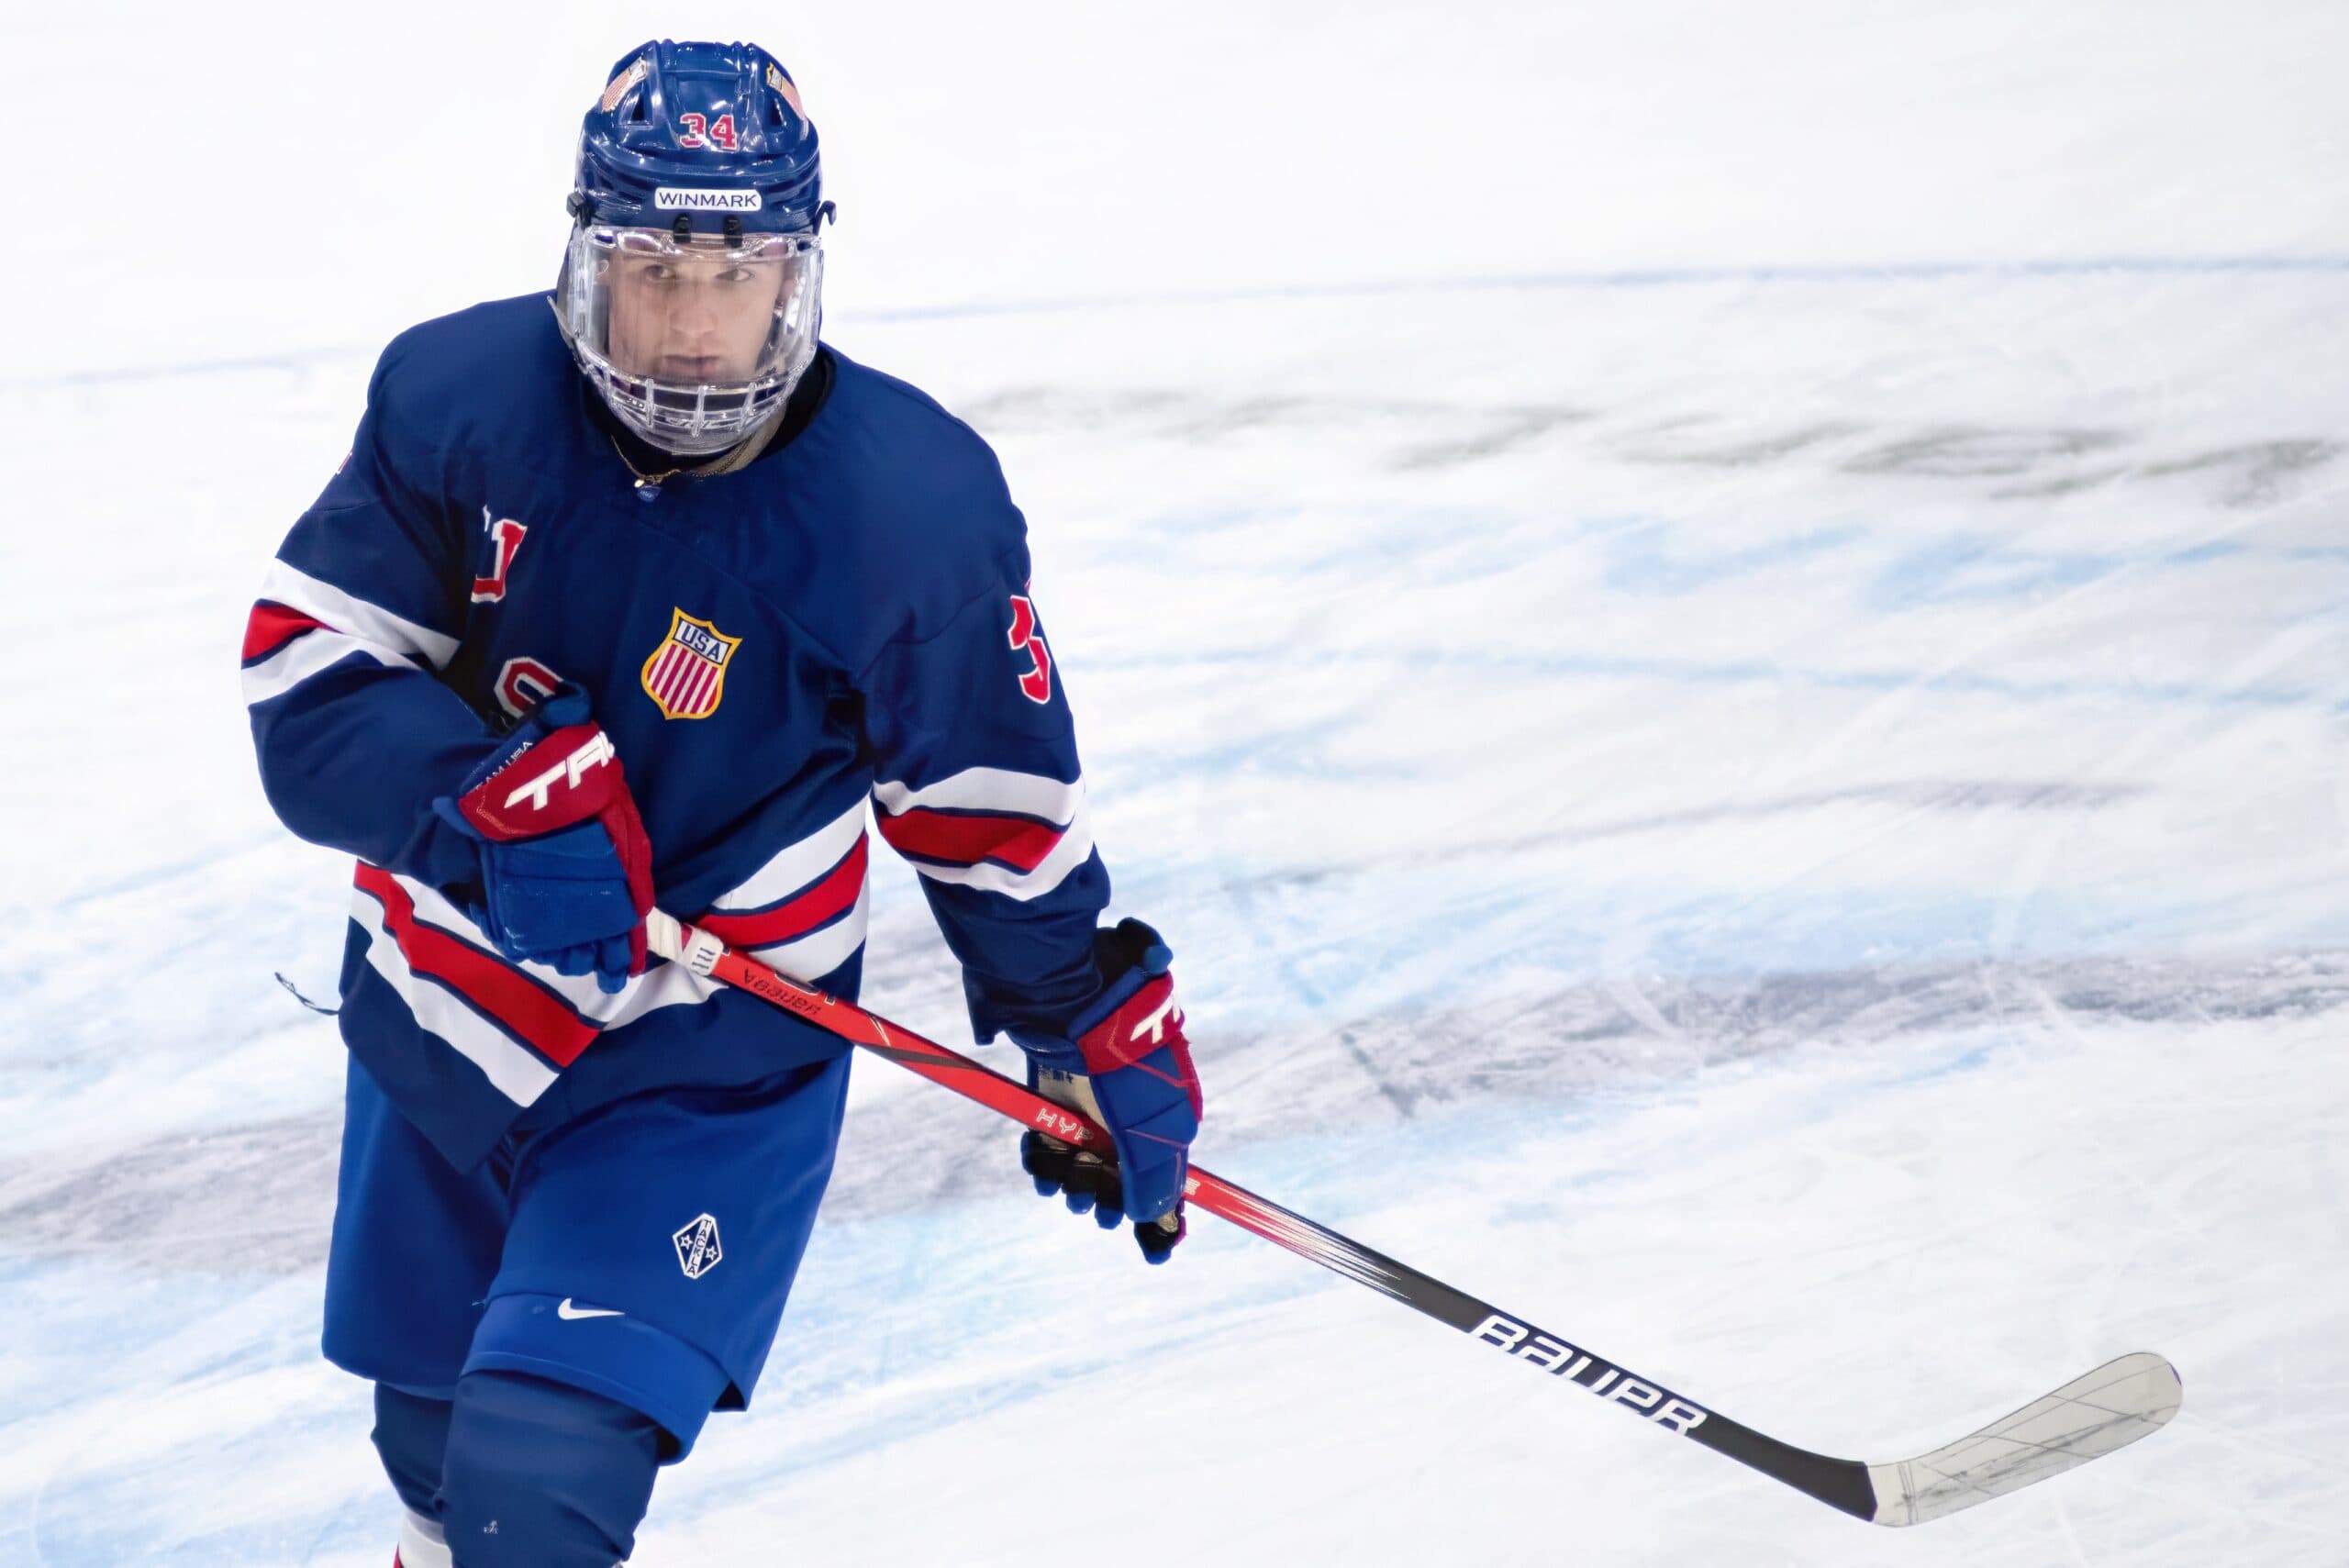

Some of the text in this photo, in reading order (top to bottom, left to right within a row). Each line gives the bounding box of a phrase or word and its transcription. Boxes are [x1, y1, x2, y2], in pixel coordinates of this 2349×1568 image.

[679, 113, 738, 151] 34
[658, 192, 758, 207] WINMARK
[681, 625, 720, 662] USA
[1469, 1314, 1709, 1437] BAUER
